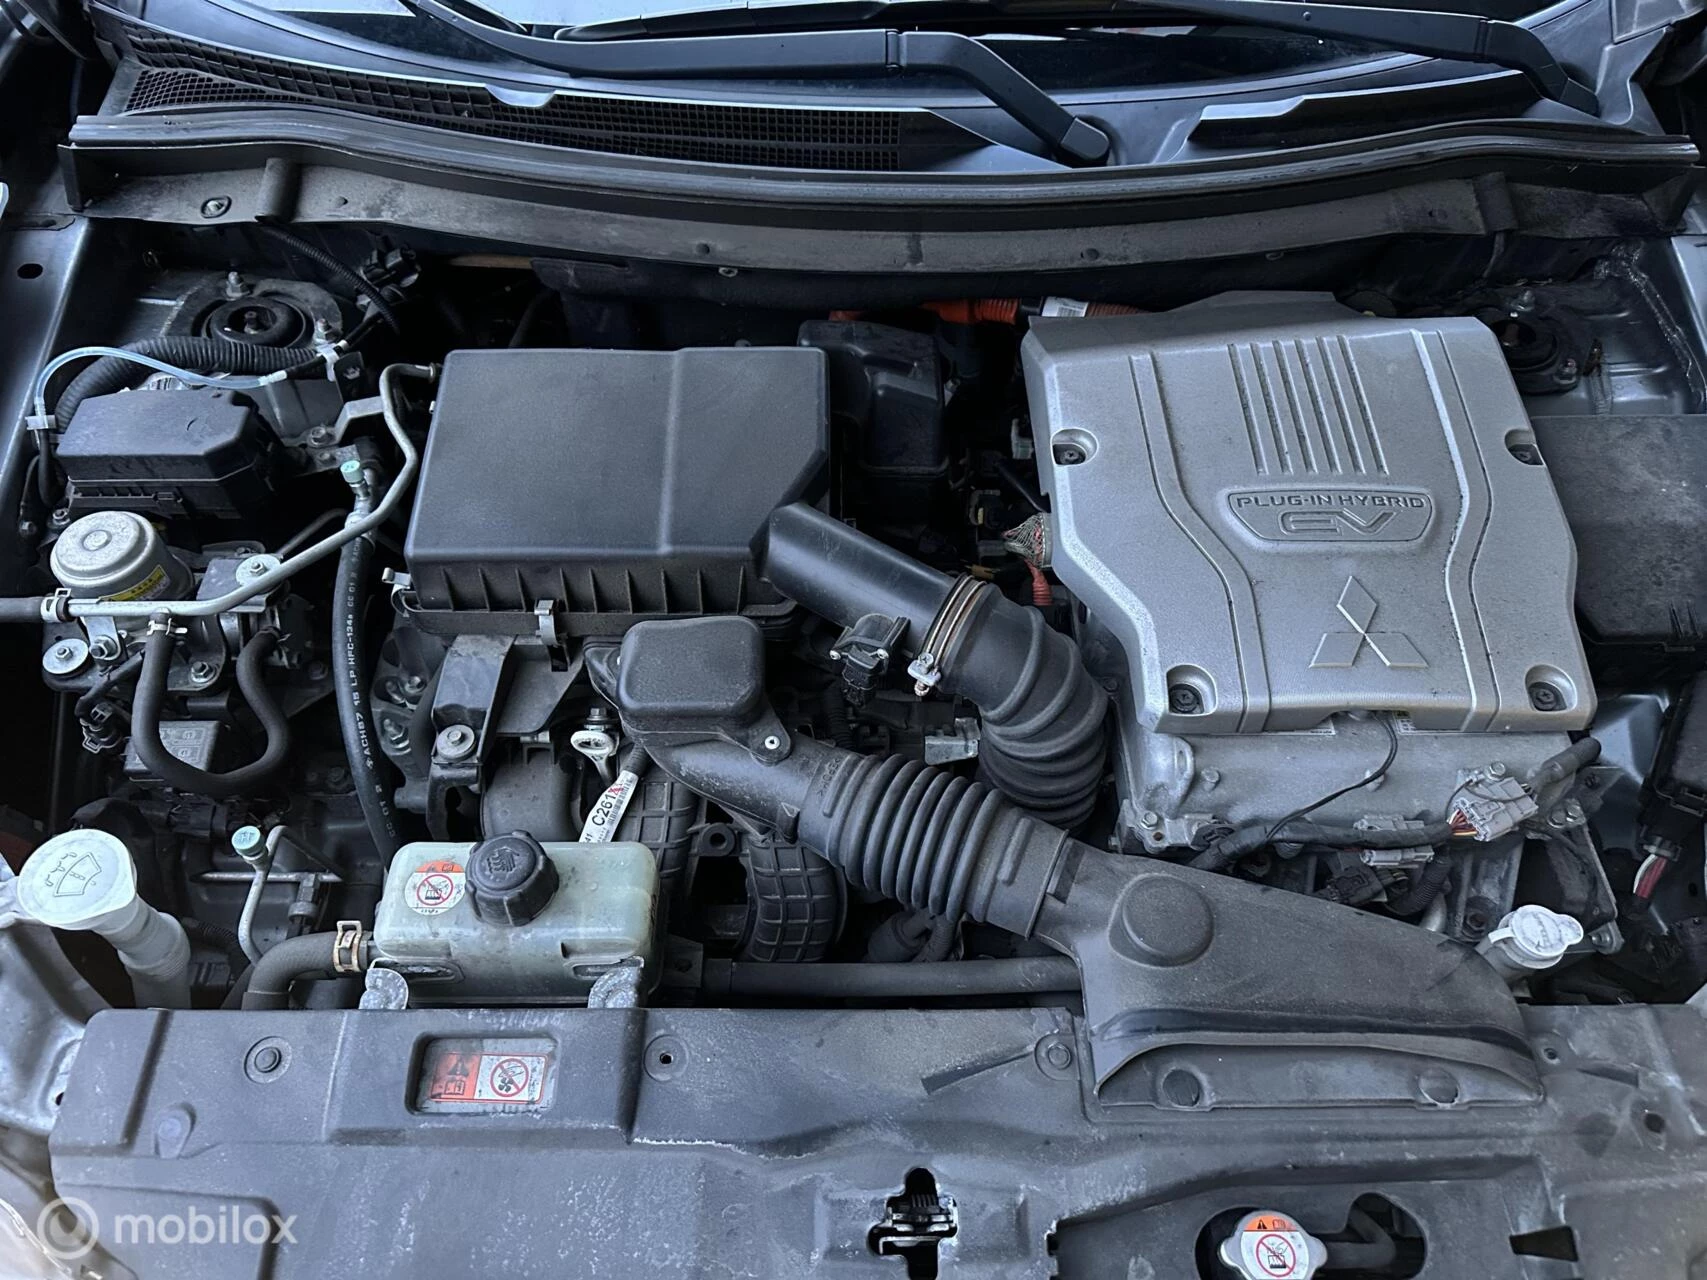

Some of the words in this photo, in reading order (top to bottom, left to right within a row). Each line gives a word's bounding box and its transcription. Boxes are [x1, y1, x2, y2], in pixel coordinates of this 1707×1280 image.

[1236, 494, 1332, 508] PLUG-IN
[1338, 494, 1426, 508] HYBRID
[1279, 507, 1398, 537] EV
[346, 614, 356, 665] HFC-134a
[349, 670, 358, 687] LP
